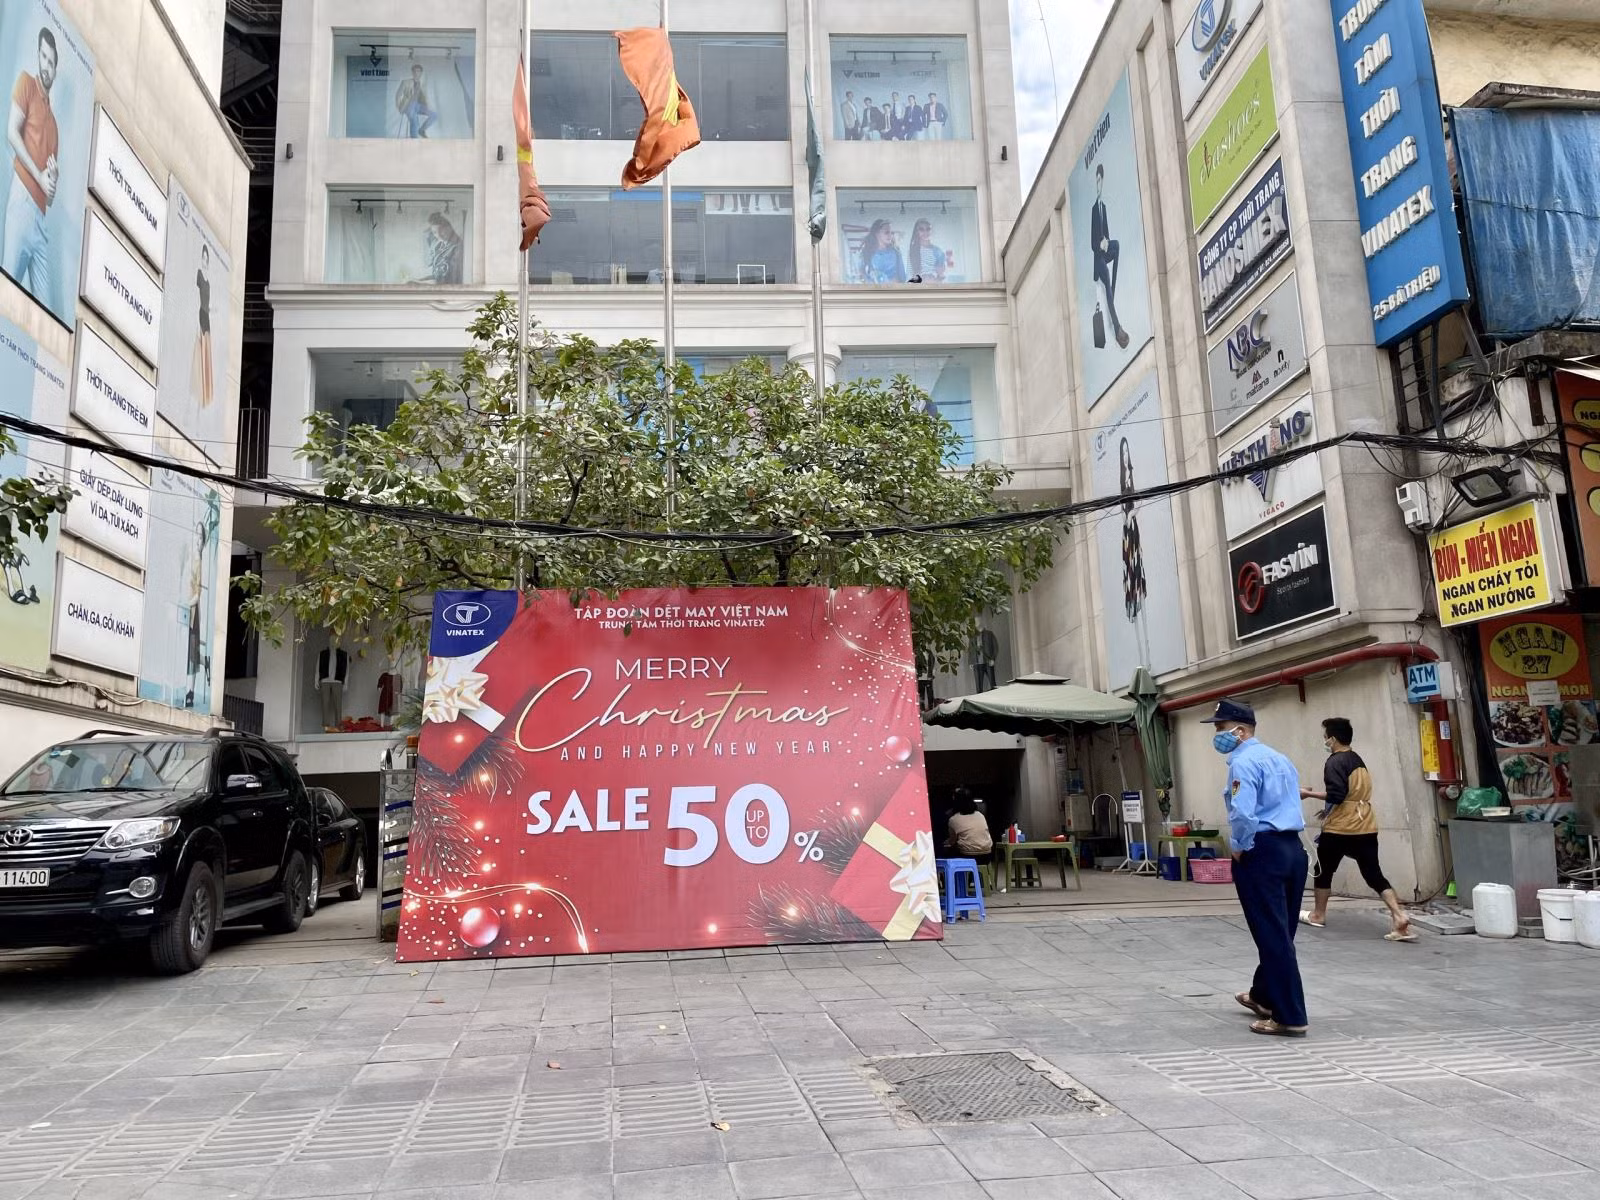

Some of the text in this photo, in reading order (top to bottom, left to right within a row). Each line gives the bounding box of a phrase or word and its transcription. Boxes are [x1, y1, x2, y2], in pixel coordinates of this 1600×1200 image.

[1338, 0, 1383, 41] TRUN
[1354, 33, 1392, 85] TÂM
[1360, 87, 1400, 139] THỜI
[1361, 136, 1417, 198] TRANG
[124, 179, 145, 214] TRANG
[144, 206, 158, 231] NAM
[1203, 241, 1220, 270] CÔNG
[1219, 231, 1228, 251] TY
[1228, 221, 1238, 242] CP
[1255, 171, 1280, 211] TRANG
[1361, 185, 1435, 258] VINATEX
[121, 284, 143, 316] TRANG
[1374, 300, 1390, 320] 25
[103, 382, 127, 411] TRANG
[1434, 538, 1461, 583] BÚN
[1465, 521, 1500, 574] MIẾN
[1498, 518, 1539, 564] NGAN
[1442, 560, 1539, 601] NGAN CHÁY TỎI
[574, 603, 789, 621] TẬP ĐOÀN DỆT MAY VIỆT NAM
[1451, 585, 1536, 618] NGAN NƯỚNG
[446, 629, 485, 637] VINATEX
[636, 619, 658, 629] TÂM
[660, 618, 685, 629] THỜI
[688, 619, 721, 628] TRANG
[724, 618, 766, 627] VINATEX
[1497, 626, 1567, 659] NGAN
[615, 656, 732, 681] MERRY
[1409, 665, 1436, 686] ATM
[1521, 655, 1551, 674] 27
[1491, 685, 1528, 698] NGAN
[514, 667, 850, 753] Christmas
[560, 740, 831, 761] AND HAPPY NEW YEAR
[526, 787, 650, 835] SALE
[746, 810, 765, 823] UP
[746, 826, 768, 839] TO
